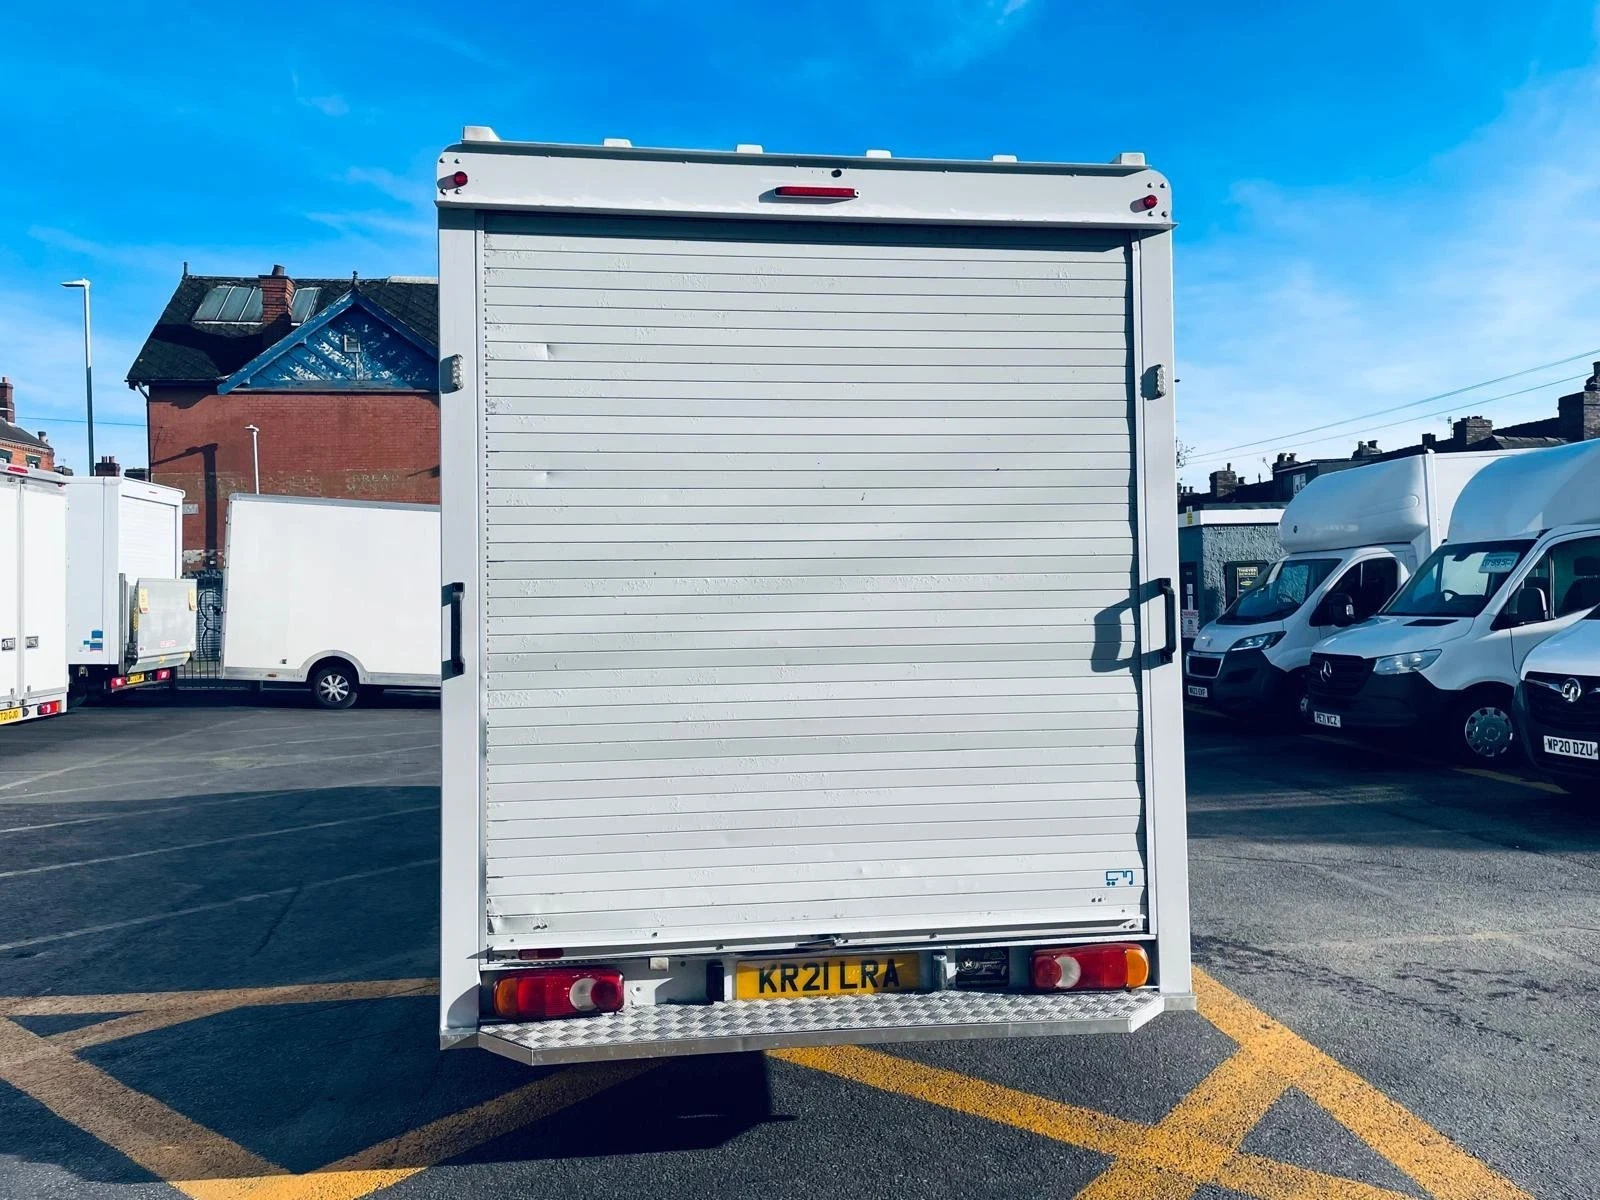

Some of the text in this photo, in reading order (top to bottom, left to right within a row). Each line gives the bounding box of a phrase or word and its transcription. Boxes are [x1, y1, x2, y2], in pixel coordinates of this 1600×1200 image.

[1547, 738, 1593, 756] WP20 DZU
[758, 959, 900, 993] KR21 LRA
